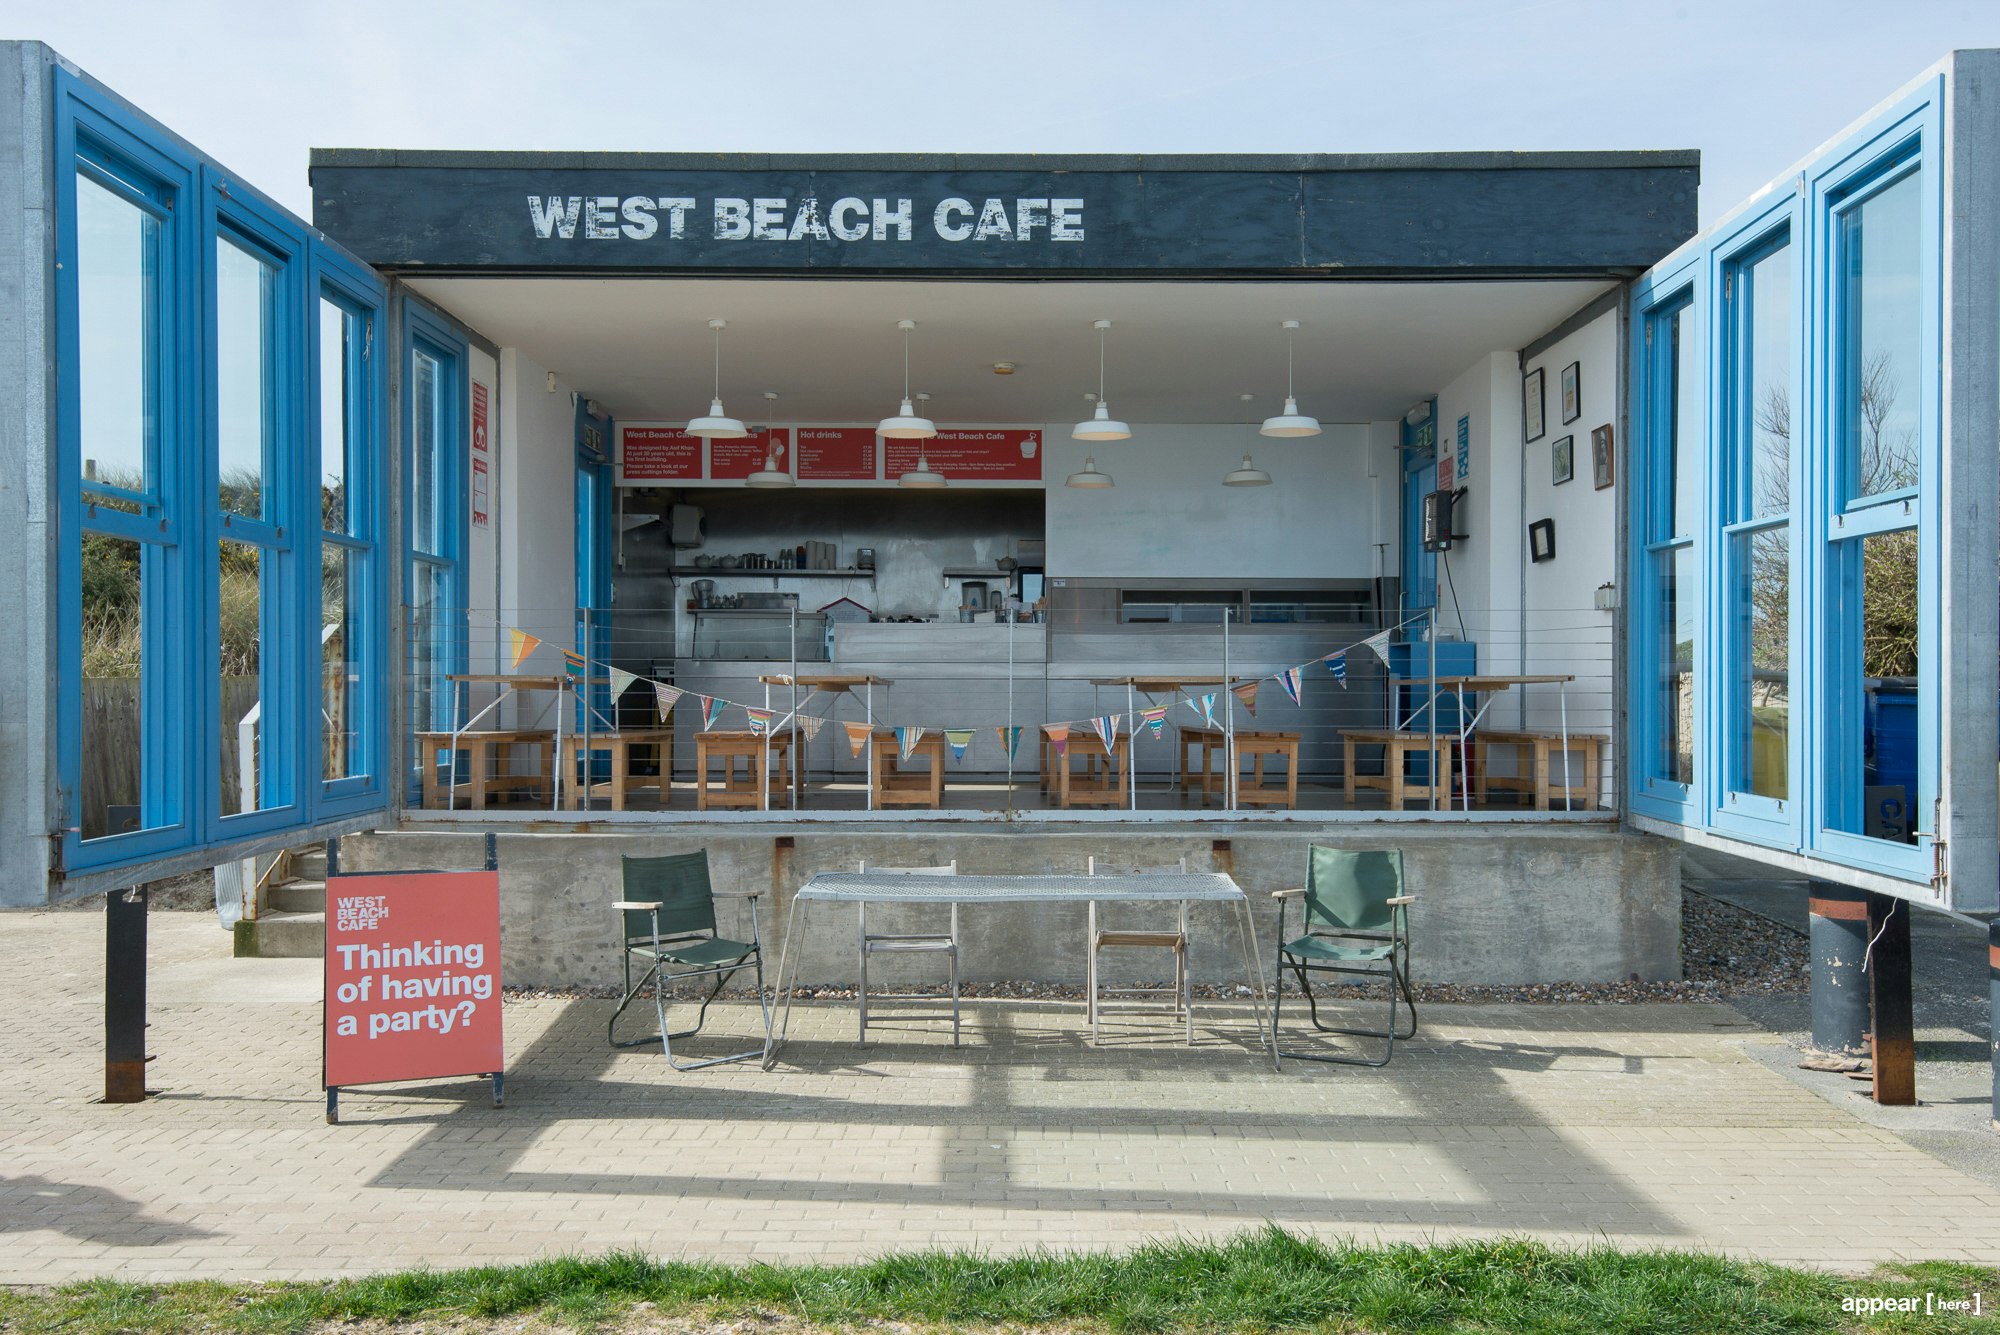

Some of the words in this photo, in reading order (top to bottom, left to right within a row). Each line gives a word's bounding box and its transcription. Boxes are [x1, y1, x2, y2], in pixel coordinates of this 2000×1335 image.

[527, 196, 696, 240] WEST
[714, 197, 912, 241] BEACH
[933, 197, 1085, 241] CAFE
[337, 895, 386, 909] WEST
[337, 906, 389, 920] BEACH
[337, 918, 378, 932] CAFE
[336, 940, 484, 971] Thinking
[336, 975, 373, 1004] of
[382, 971, 492, 1000] having
[336, 1014, 358, 1036] a
[369, 1000, 476, 1040] party?
